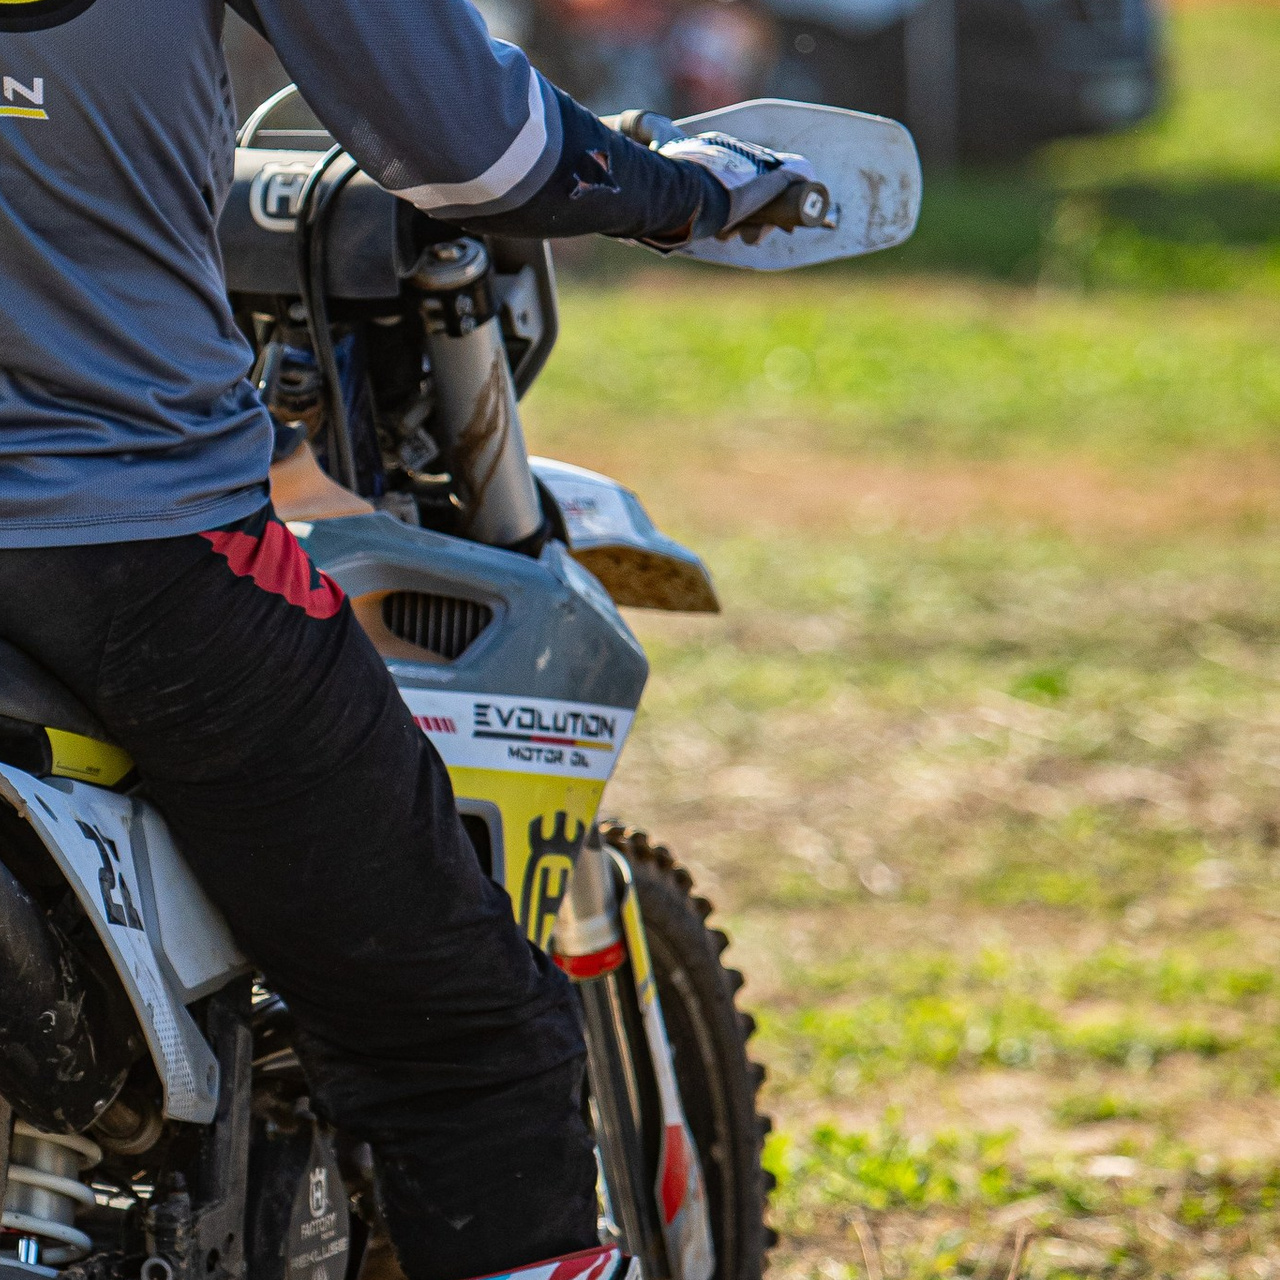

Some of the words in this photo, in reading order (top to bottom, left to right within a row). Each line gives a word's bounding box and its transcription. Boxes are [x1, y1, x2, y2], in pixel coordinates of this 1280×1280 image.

[473, 703, 617, 739] EVOLUTION
[507, 746, 564, 765] MOTOR
[570, 751, 590, 768] OIL
